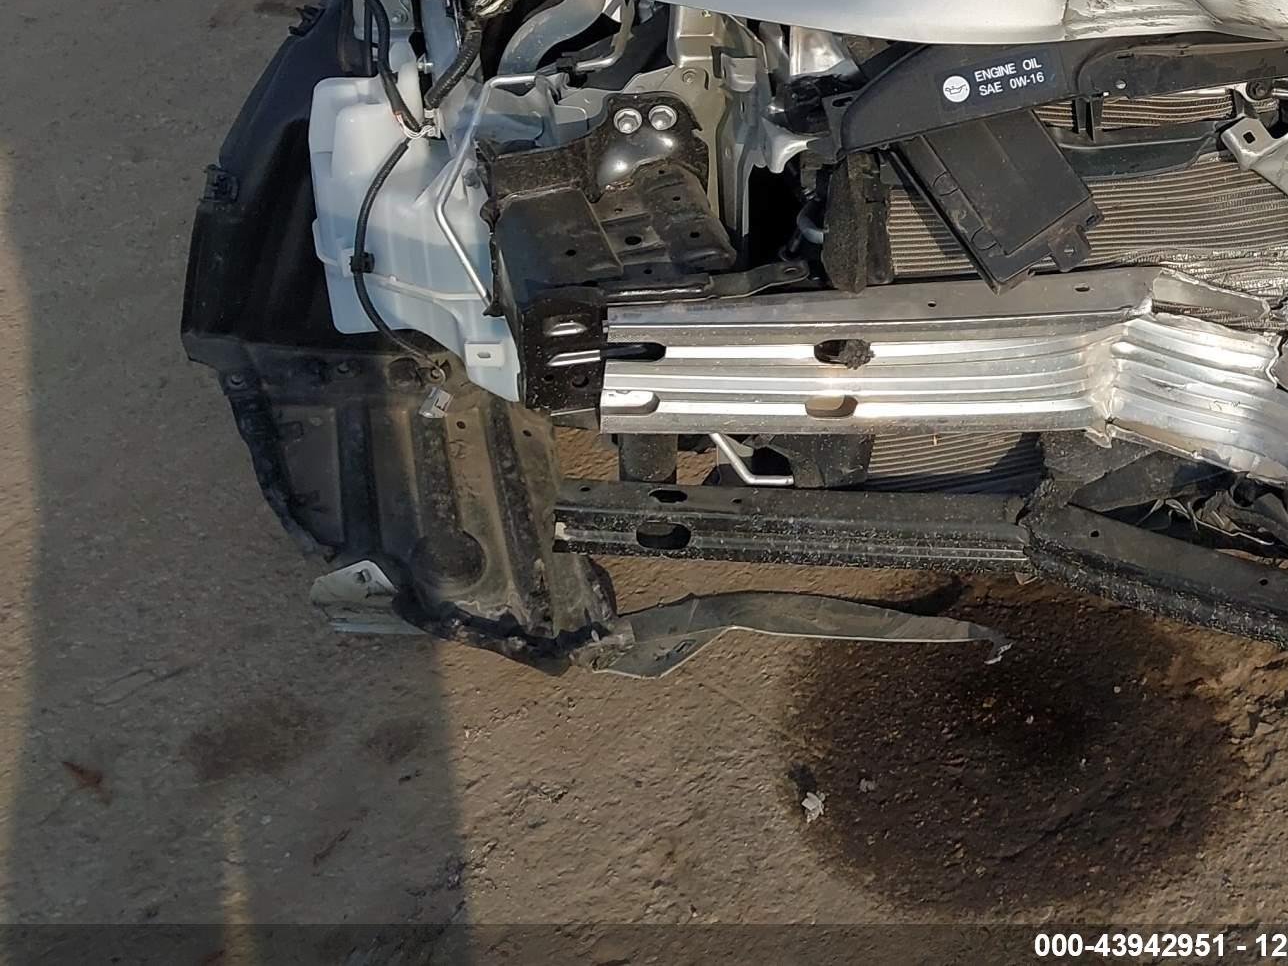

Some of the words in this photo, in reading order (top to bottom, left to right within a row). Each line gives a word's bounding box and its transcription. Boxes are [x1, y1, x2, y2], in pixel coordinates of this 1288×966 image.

[974, 62, 1017, 82] ENGINE
[1022, 57, 1043, 71] OIL
[979, 81, 1004, 96] SAE
[1009, 71, 1045, 90] 0W-16
